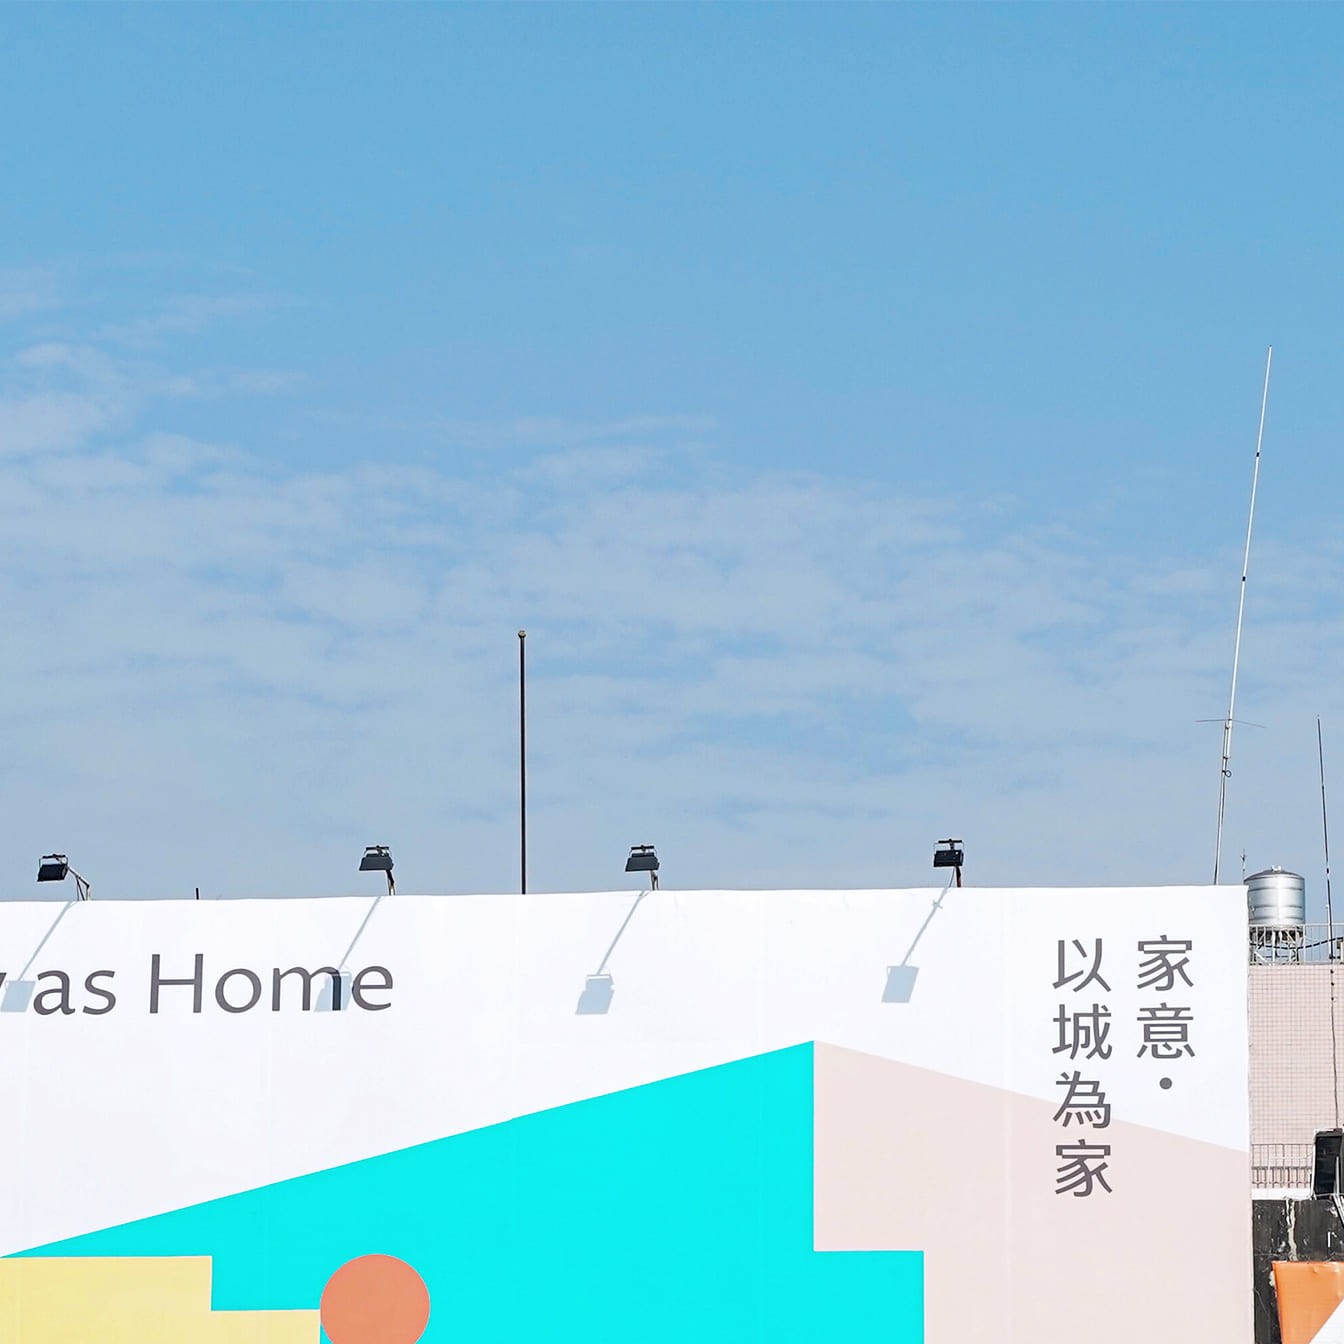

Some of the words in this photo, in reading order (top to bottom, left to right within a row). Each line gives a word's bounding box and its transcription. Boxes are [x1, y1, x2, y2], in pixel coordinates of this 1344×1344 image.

[32, 968, 117, 1015] as
[150, 953, 394, 1015] Home
[1051, 937, 1113, 1198] 以城為家
